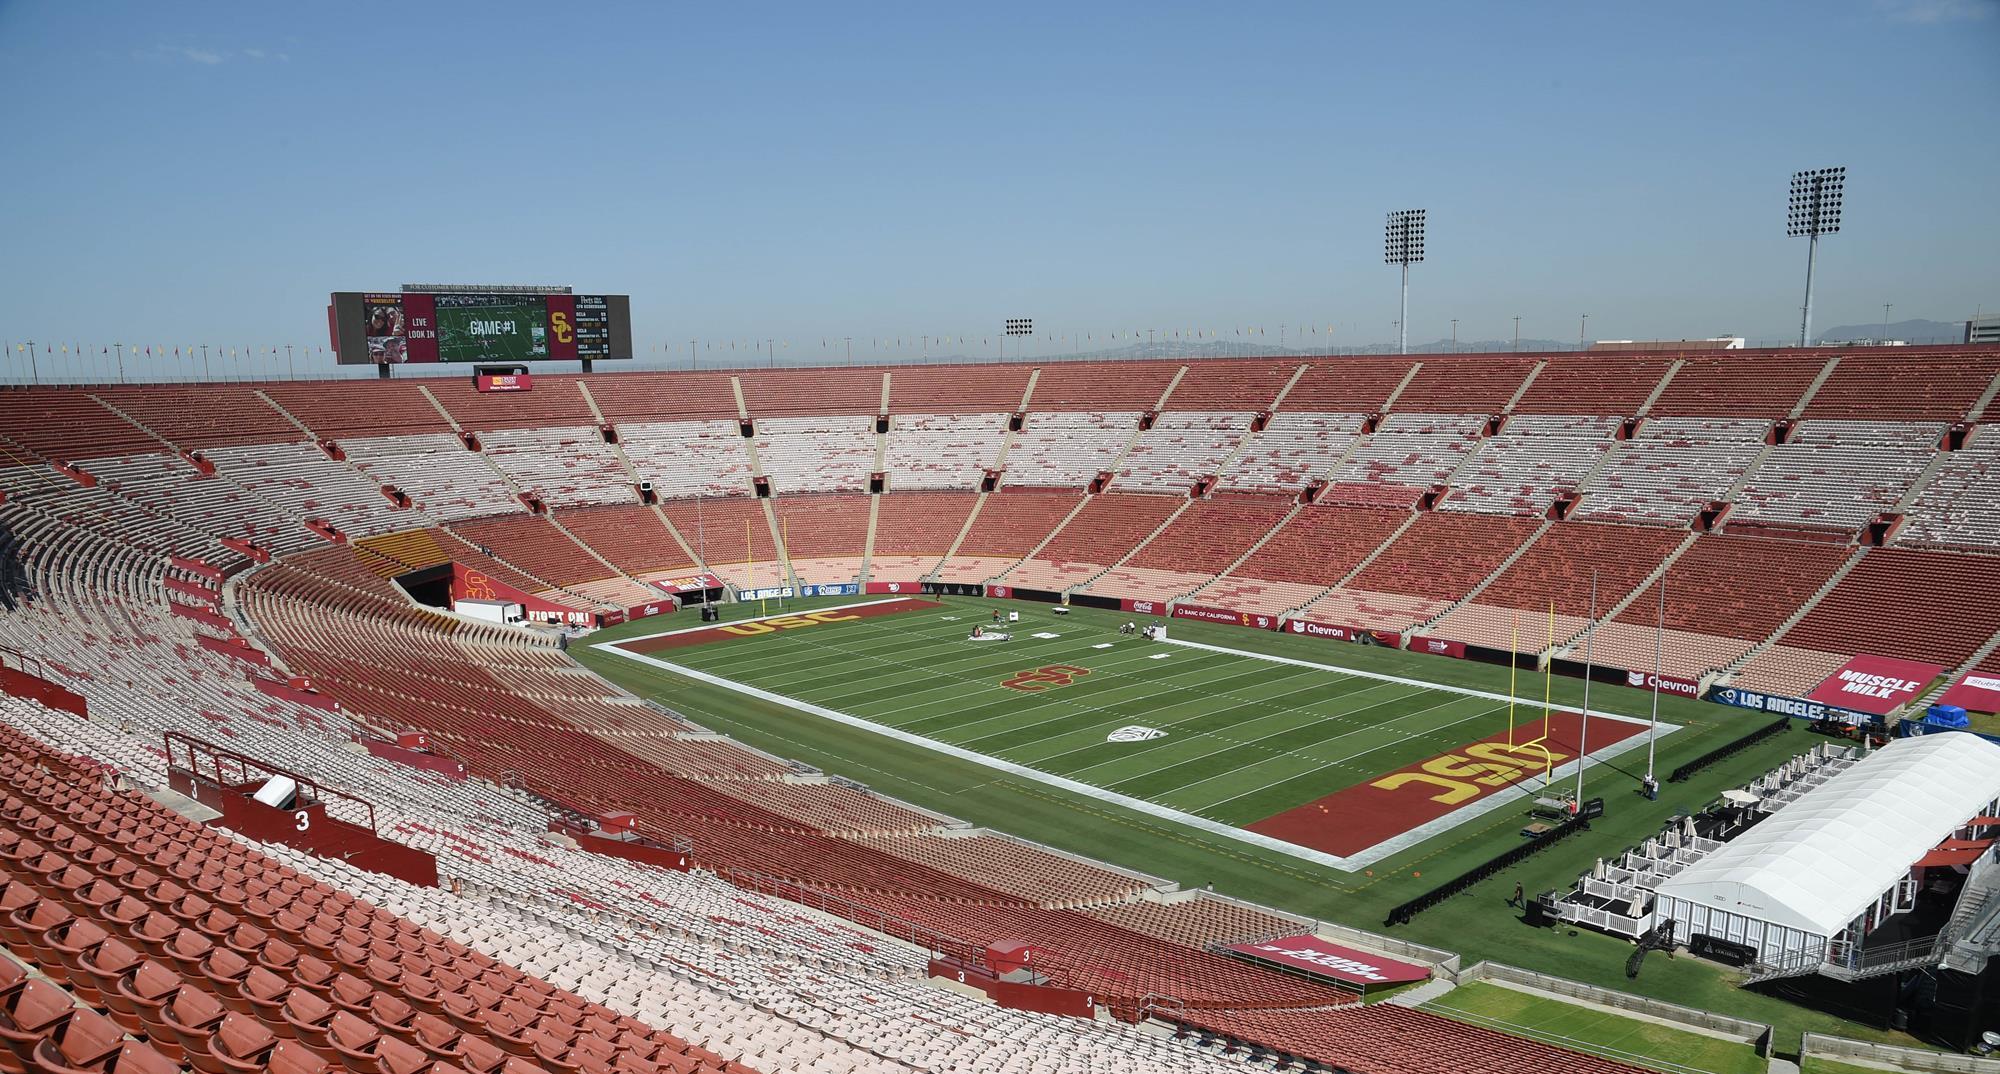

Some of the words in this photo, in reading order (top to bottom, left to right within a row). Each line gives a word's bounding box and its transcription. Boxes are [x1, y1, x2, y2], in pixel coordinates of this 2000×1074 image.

[412, 318, 427, 327] LIVE
[470, 320, 502, 335] GAME
[503, 320, 517, 335] #1
[408, 330, 425, 339] LOOK
[427, 330, 435, 339] IN
[740, 590, 757, 601] LOS
[757, 587, 793, 600] ANGEES
[717, 611, 861, 635] USC
[1206, 612, 1236, 621] CALIFORNIA
[1307, 623, 1344, 637] Chevron
[1647, 675, 1697, 694] Chevron
[1838, 669, 1920, 693] MUSCLE
[1841, 682, 1896, 699] MILK
[1740, 692, 1764, 709] LOS
[1766, 695, 1825, 720] ANGELES
[1370, 742, 1569, 805] USC
[295, 811, 310, 831] 3
[1024, 950, 1030, 962] 3
[958, 971, 965, 983] 3
[1087, 996, 1092, 1007] 3
